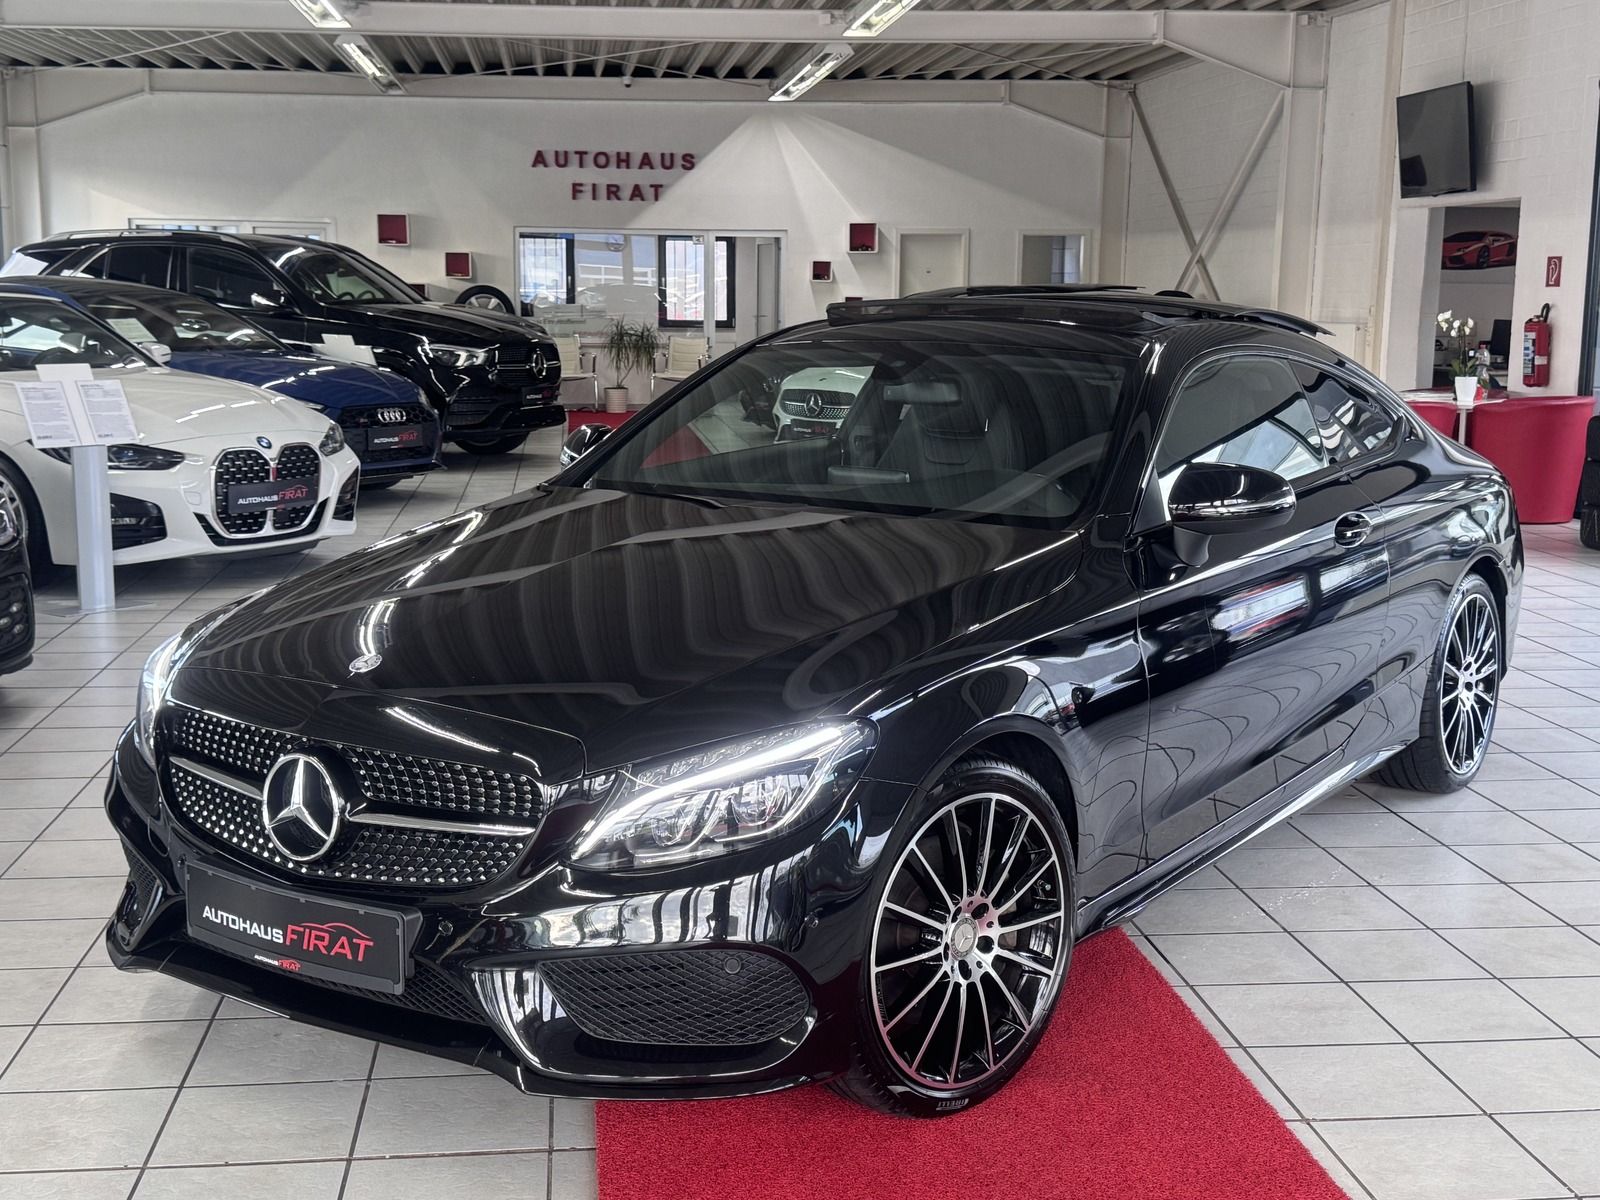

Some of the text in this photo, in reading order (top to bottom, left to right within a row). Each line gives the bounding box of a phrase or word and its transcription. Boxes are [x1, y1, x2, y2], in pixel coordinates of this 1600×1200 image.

[531, 150, 696, 171] AUTOHAUS
[571, 182, 664, 202] FIRAT
[237, 488, 309, 505] AUTOHAUS FIRAT
[202, 905, 374, 962] AUTOHAUS FIRAT
[278, 960, 301, 971] FIRAT
